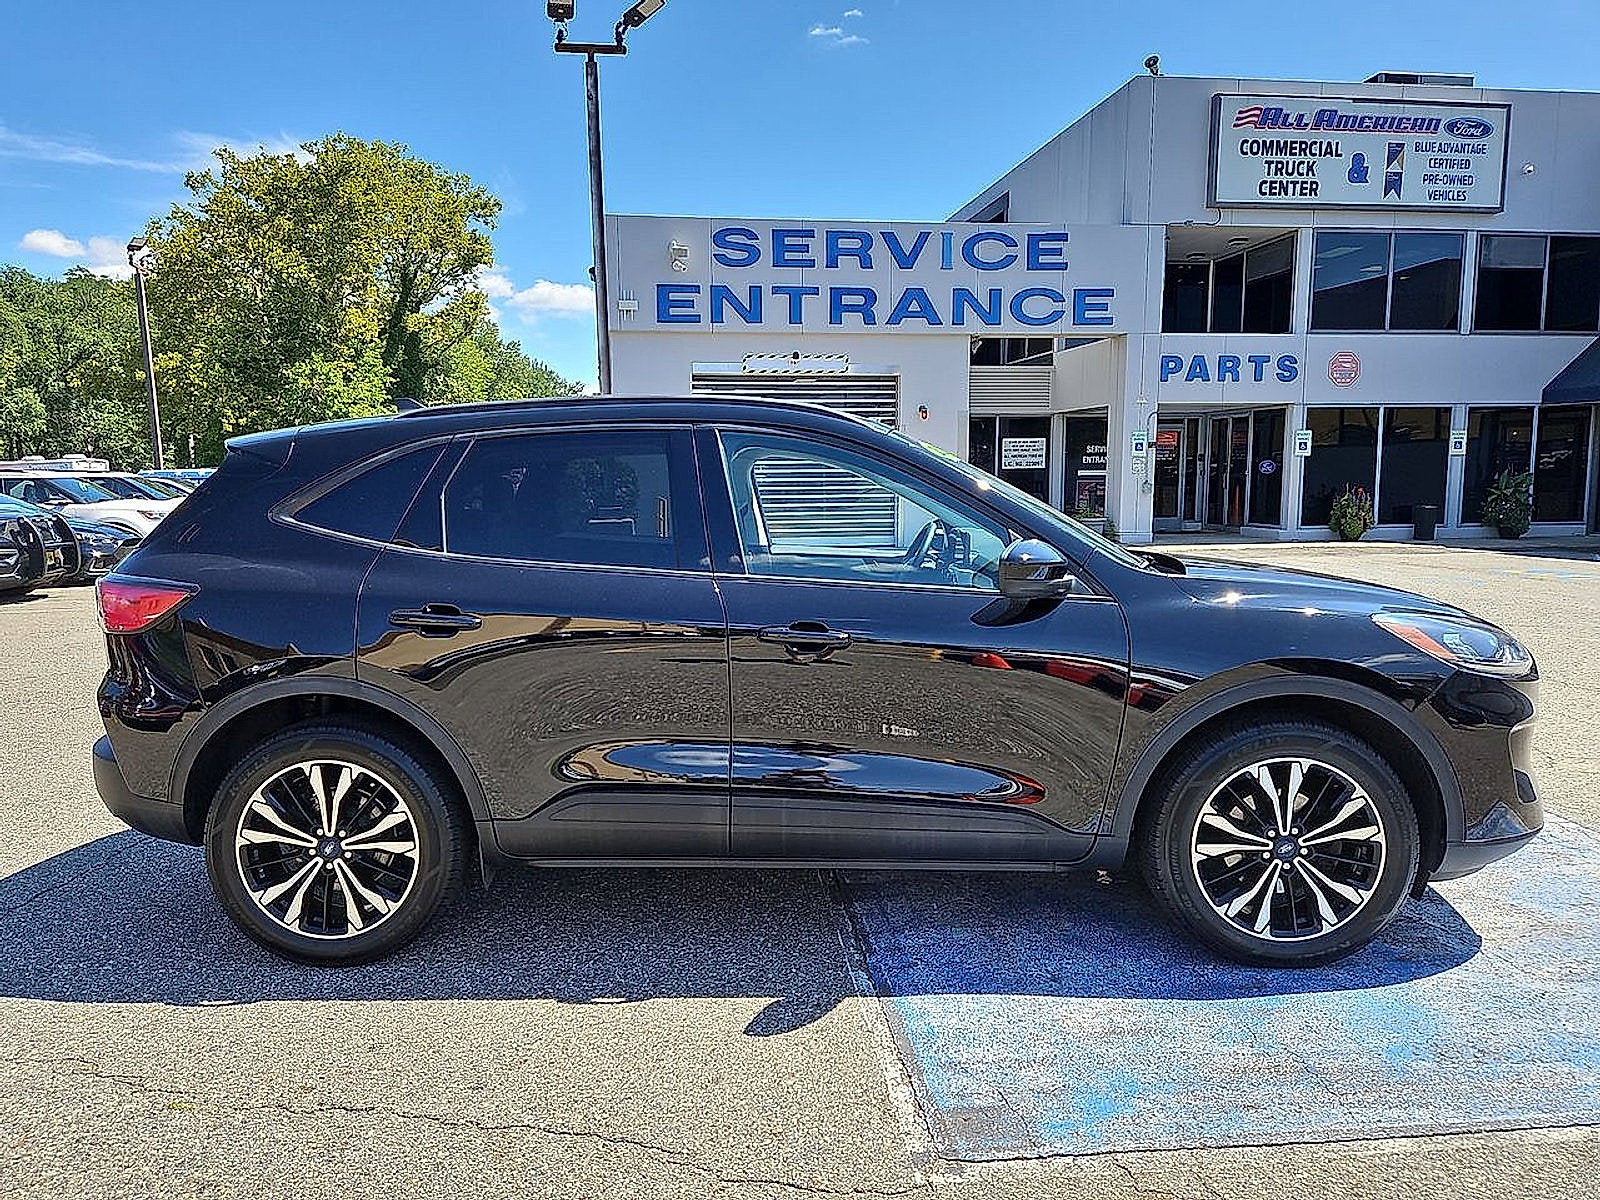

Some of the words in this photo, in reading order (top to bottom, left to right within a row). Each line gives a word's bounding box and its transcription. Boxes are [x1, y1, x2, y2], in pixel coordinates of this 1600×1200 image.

[1239, 139, 1343, 157] COMMERCIAL
[1414, 141, 1436, 153] BLUE
[1437, 142, 1487, 154] ADVANTAGE
[1264, 159, 1318, 177] TRUCK
[1347, 152, 1370, 184] &
[1428, 157, 1471, 170] CERTIFIED
[1258, 179, 1319, 197] CENTER
[1422, 173, 1474, 186] PRE-OWNED
[1427, 189, 1467, 201] VEHICLES
[712, 227, 1069, 272] SERVICE
[656, 283, 1115, 326] ENTRANCE
[1160, 354, 1299, 383] PARTS
